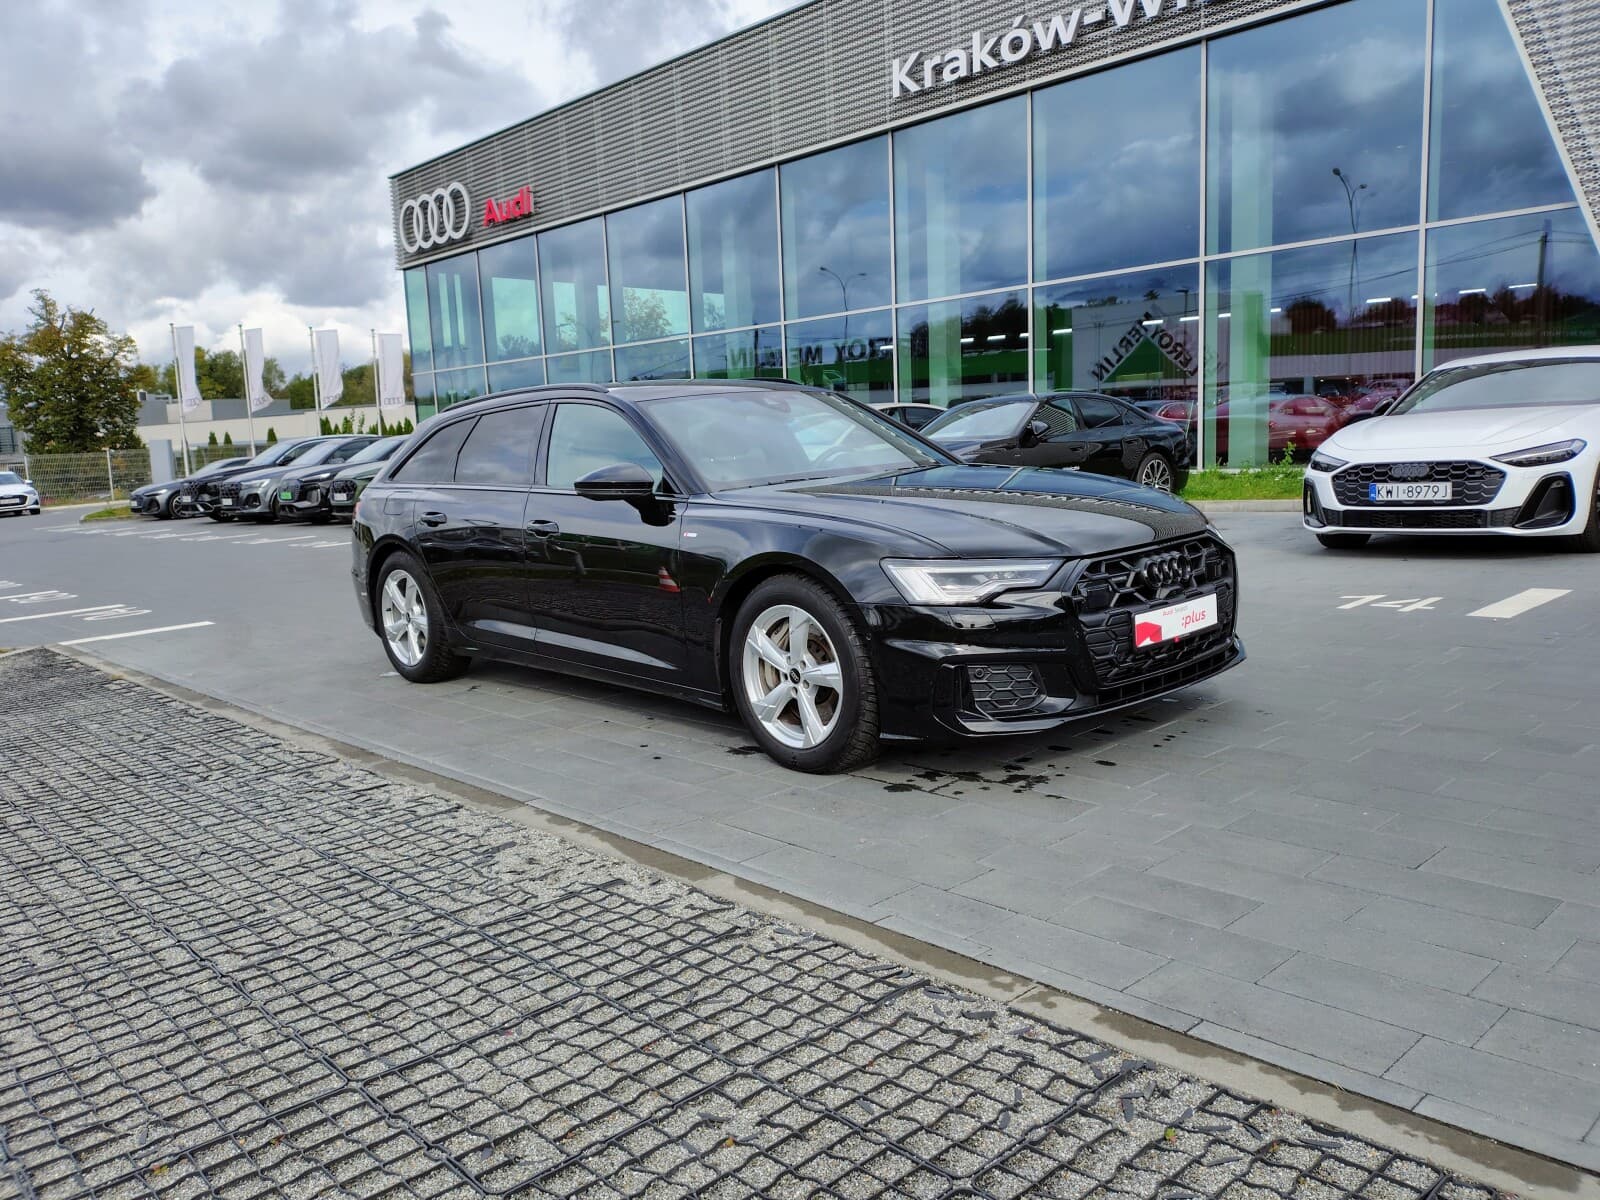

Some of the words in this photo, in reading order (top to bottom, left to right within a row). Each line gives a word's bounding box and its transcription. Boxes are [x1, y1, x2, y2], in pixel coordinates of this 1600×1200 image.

[892, 0, 1188, 98] Kraków-W
[482, 185, 534, 226] Audi
[1377, 485, 1399, 499] KWI
[1406, 484, 1448, 498] 8979J
[1336, 594, 1443, 612] 74
